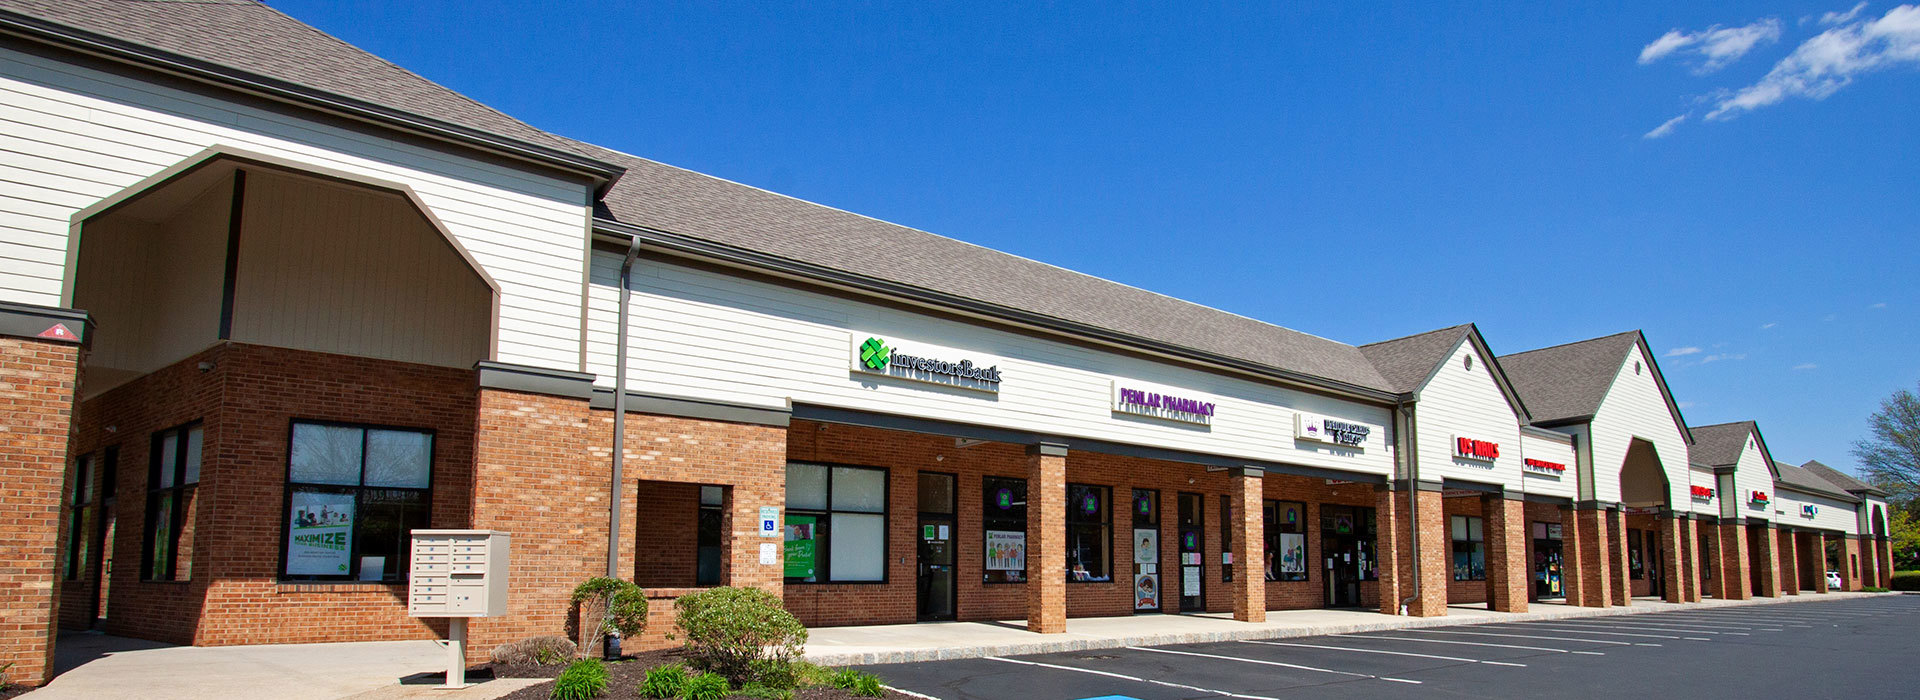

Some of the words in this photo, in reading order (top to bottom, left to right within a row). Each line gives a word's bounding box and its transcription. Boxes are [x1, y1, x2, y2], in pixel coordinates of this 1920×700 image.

[55, 328, 64, 336] R
[890, 347, 1003, 382] investorsBank
[1120, 387, 1161, 408] PENLAR
[1162, 395, 1216, 417] PHARMACY
[1457, 437, 1473, 454] US
[1473, 440, 1500, 458] NAILS
[294, 532, 347, 546] MAXIMIZE
